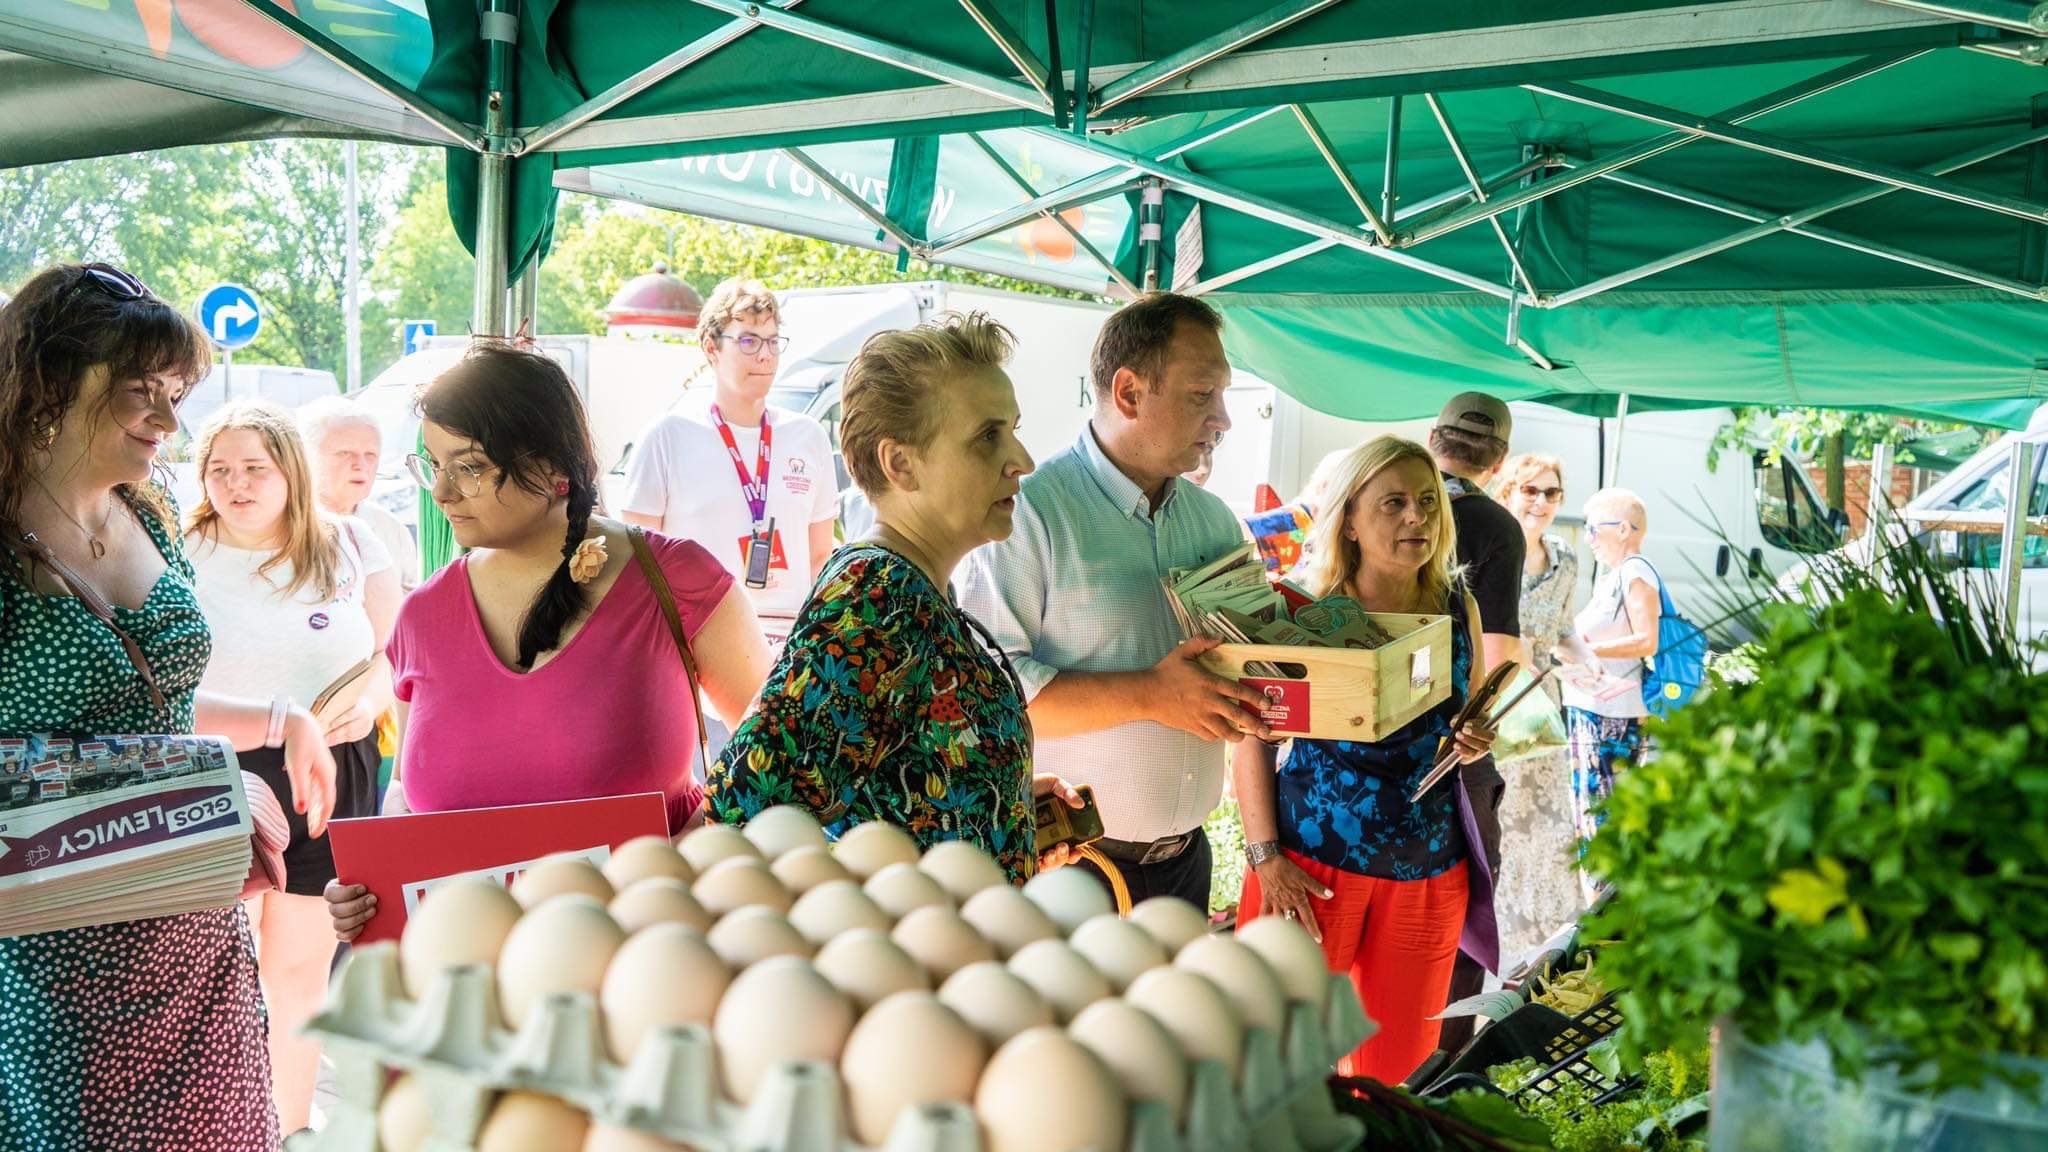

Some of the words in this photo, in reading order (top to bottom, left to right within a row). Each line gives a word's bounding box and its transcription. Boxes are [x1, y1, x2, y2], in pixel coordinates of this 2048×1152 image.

[1078, 376, 1092, 408] K
[173, 797, 232, 827] GŁOS
[57, 805, 166, 858] LEWICY
